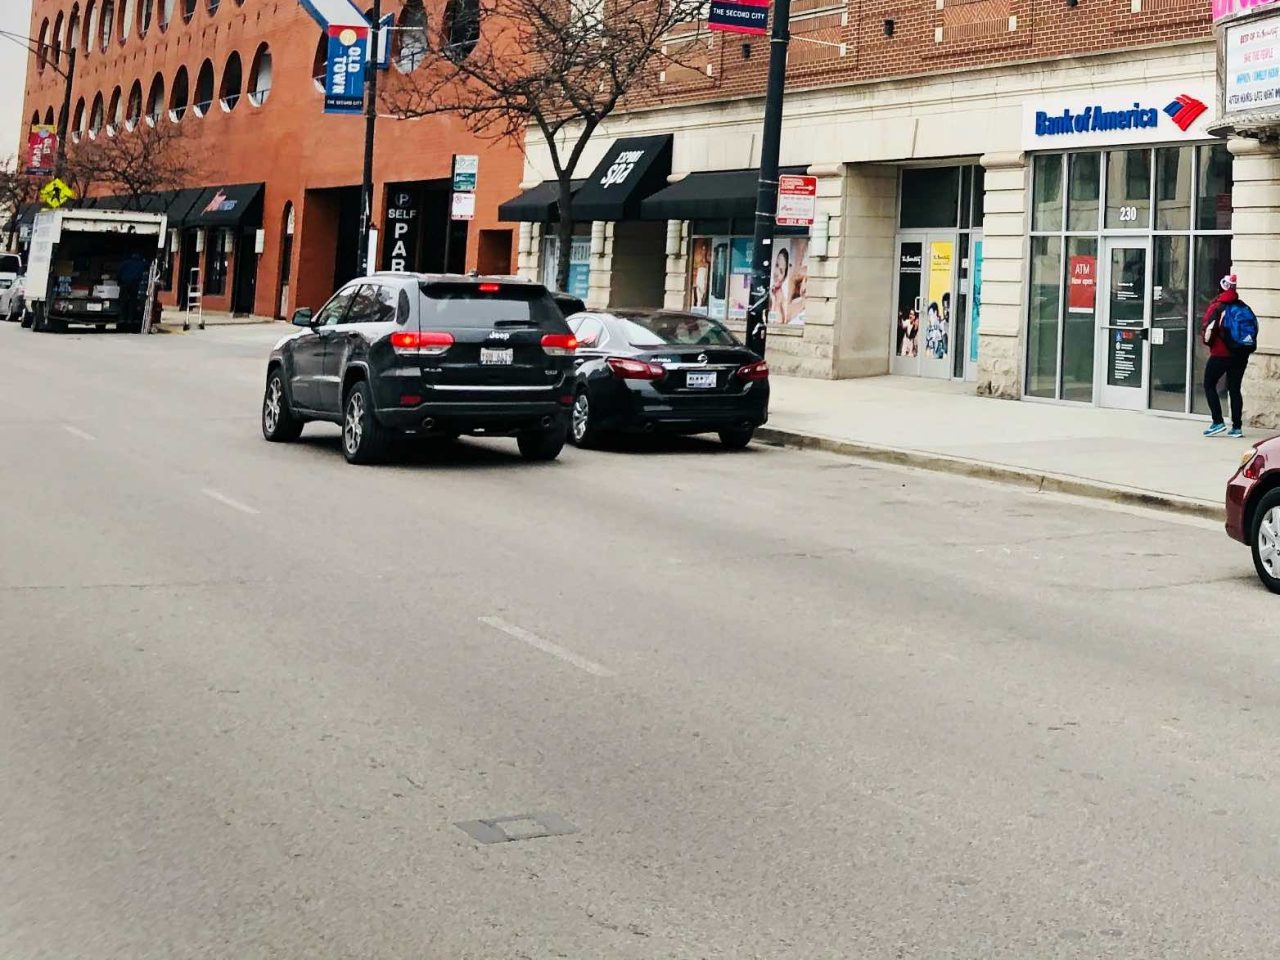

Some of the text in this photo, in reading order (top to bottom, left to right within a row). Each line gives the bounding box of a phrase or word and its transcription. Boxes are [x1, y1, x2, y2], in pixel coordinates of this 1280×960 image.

[713, 7, 765, 20] THE SECOND CITY
[348, 46, 361, 72] OLD
[332, 56, 347, 94] TOWN
[1035, 103, 1158, 136] Bank of America
[600, 163, 634, 189] spa
[388, 208, 416, 219] SELF
[1119, 207, 1137, 221] 230
[391, 223, 408, 272] PAR
[1075, 264, 1090, 275] ATM
[1071, 277, 1093, 287] Now open
[489, 331, 509, 341] Jeep
